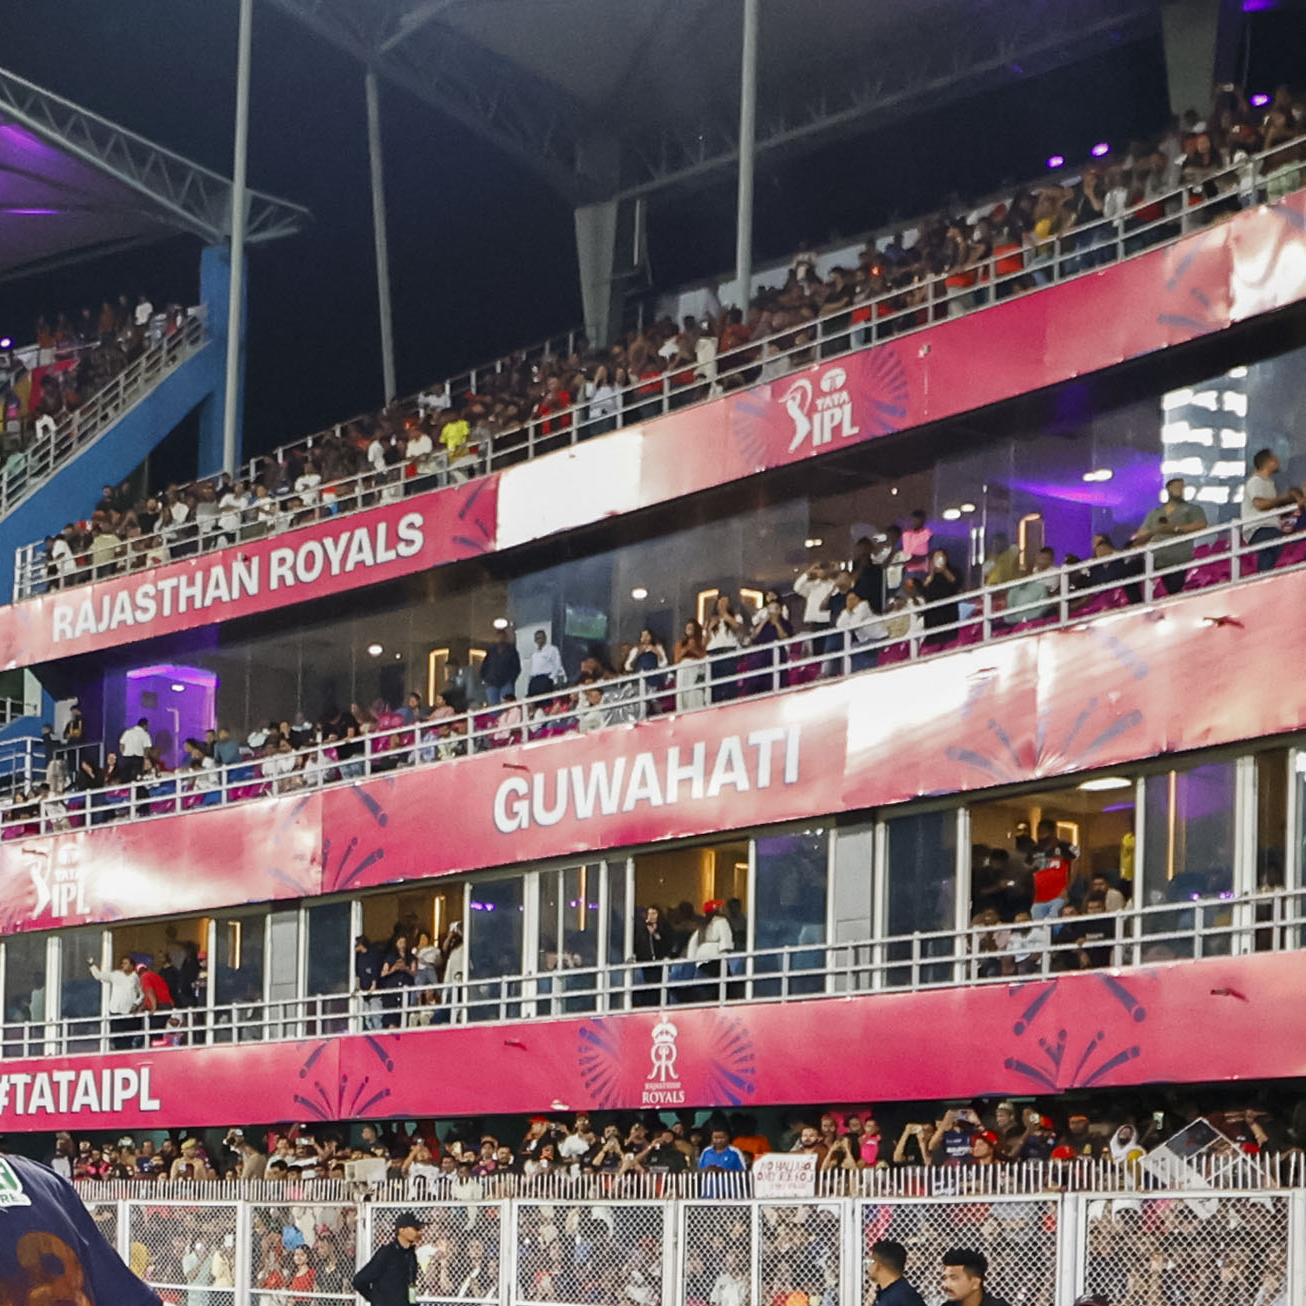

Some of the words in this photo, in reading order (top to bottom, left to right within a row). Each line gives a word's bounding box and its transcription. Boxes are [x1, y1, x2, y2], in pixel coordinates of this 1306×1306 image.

[812, 402, 860, 447] IPL
[51, 554, 260, 643] RAJASTHAN
[269, 512, 425, 591] ROYALS
[492, 723, 802, 834] GUWAHATI
[51, 874, 91, 918] IPL
[642, 1091, 686, 1104] ROYALS
